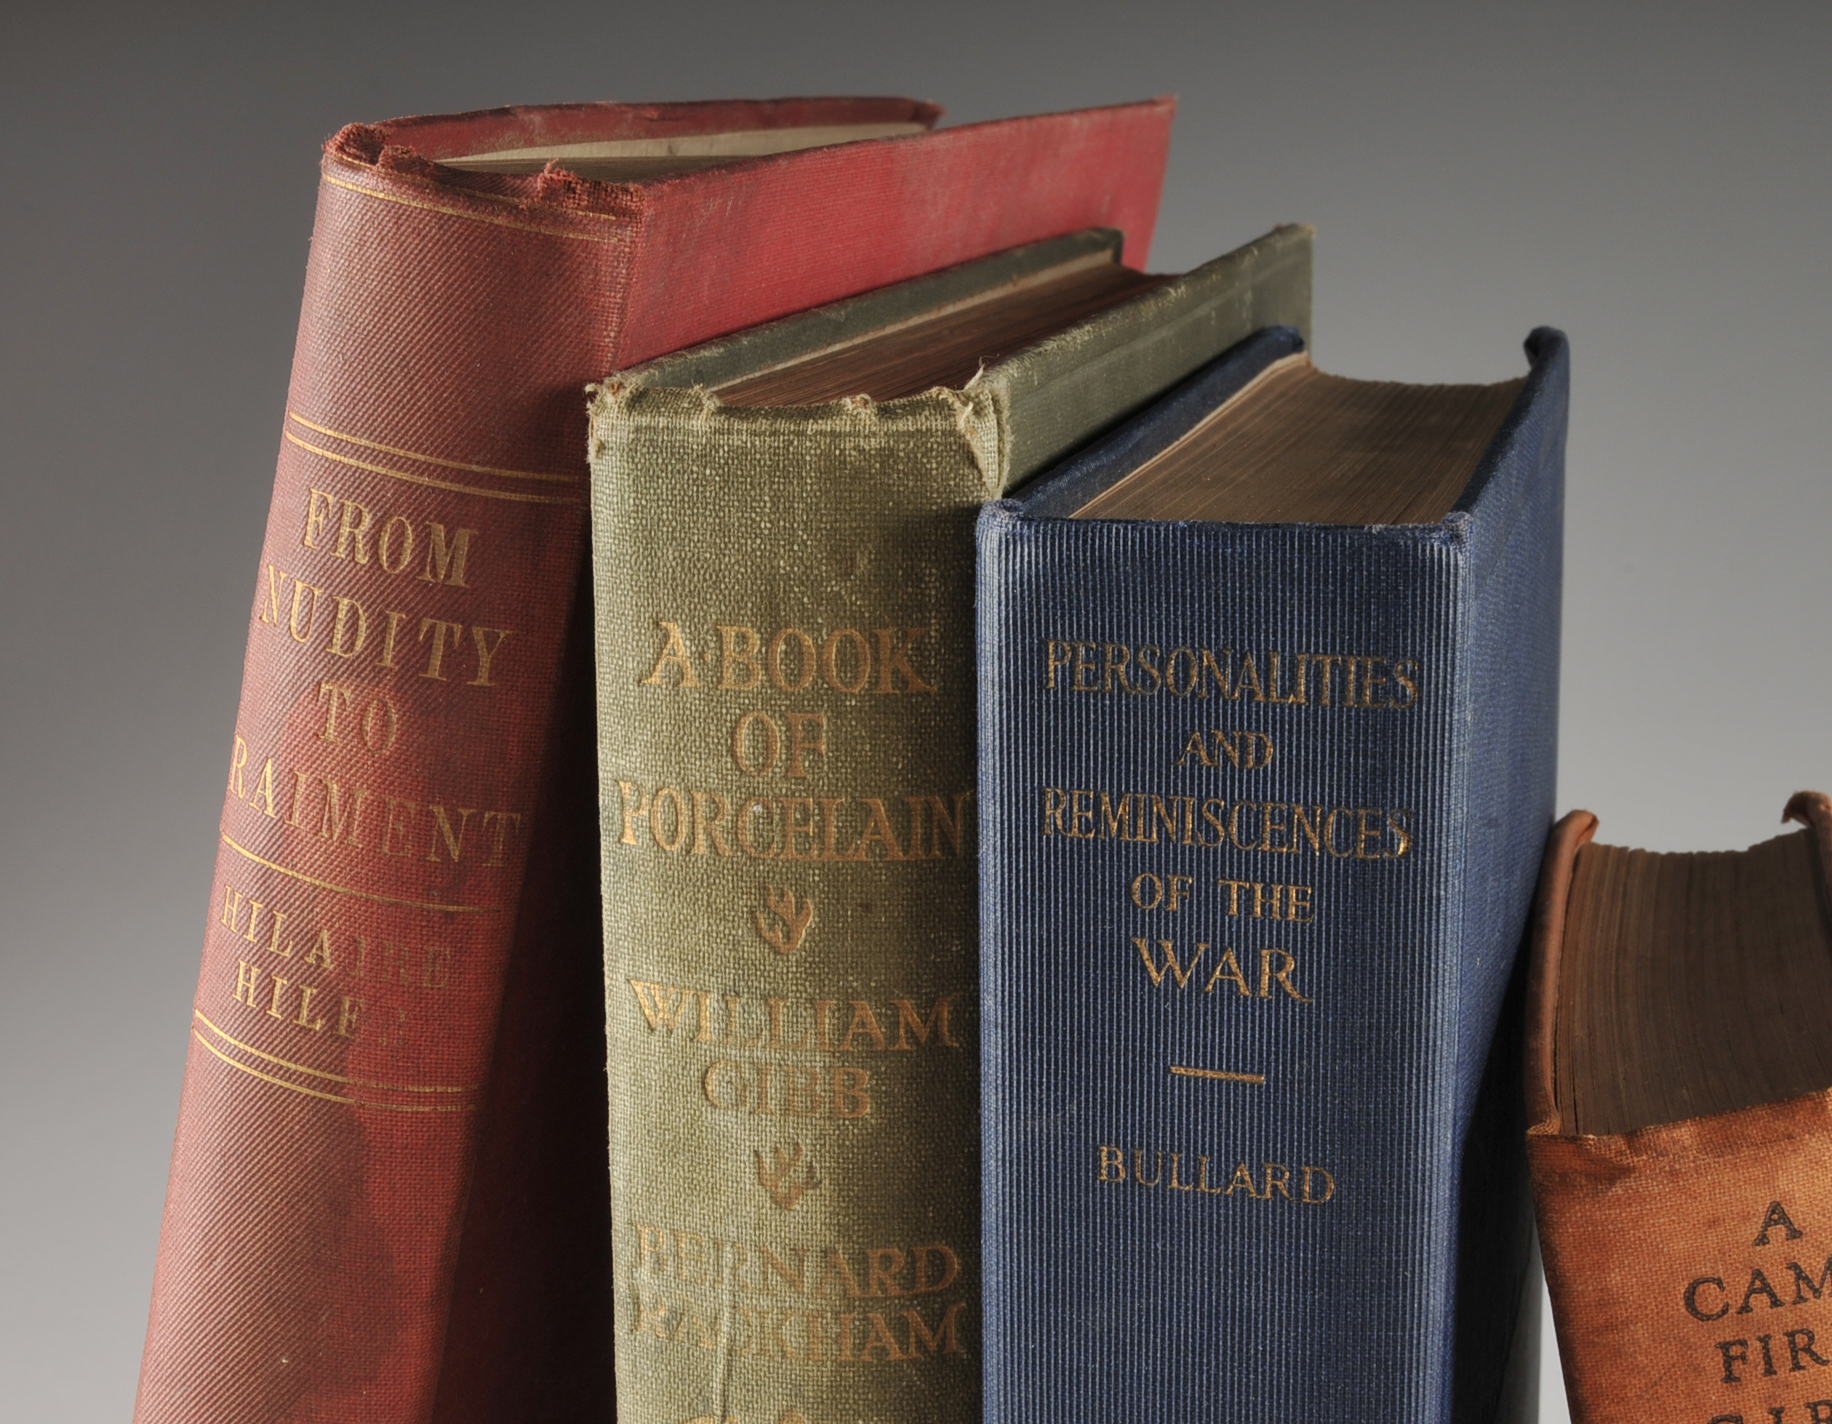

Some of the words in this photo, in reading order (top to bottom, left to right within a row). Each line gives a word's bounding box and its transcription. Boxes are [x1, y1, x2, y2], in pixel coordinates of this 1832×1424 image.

[303, 487, 478, 588] FROM
[259, 564, 513, 687] NUDITY
[642, 621, 700, 688] A
[716, 624, 937, 695] BOOK
[1045, 638, 1420, 709] PERSONALITIES
[318, 682, 398, 755] TO
[733, 711, 826, 779] OF
[1175, 729, 1275, 769] AND
[230, 734, 522, 867] RAIMENT
[618, 780, 974, 862] PORCELAIN
[1043, 787, 1413, 859] REMINISCENCES
[1131, 872, 1194, 911] OF
[1217, 878, 1315, 923] THE
[1131, 936, 1314, 1003] WAR
[628, 978, 961, 1052] WILLIAM
[1098, 1144, 1336, 1204] BULLARD
[1752, 1200, 1804, 1246] A
[1683, 1254, 1832, 1322] CAM
[1714, 1328, 1831, 1384] FIR
